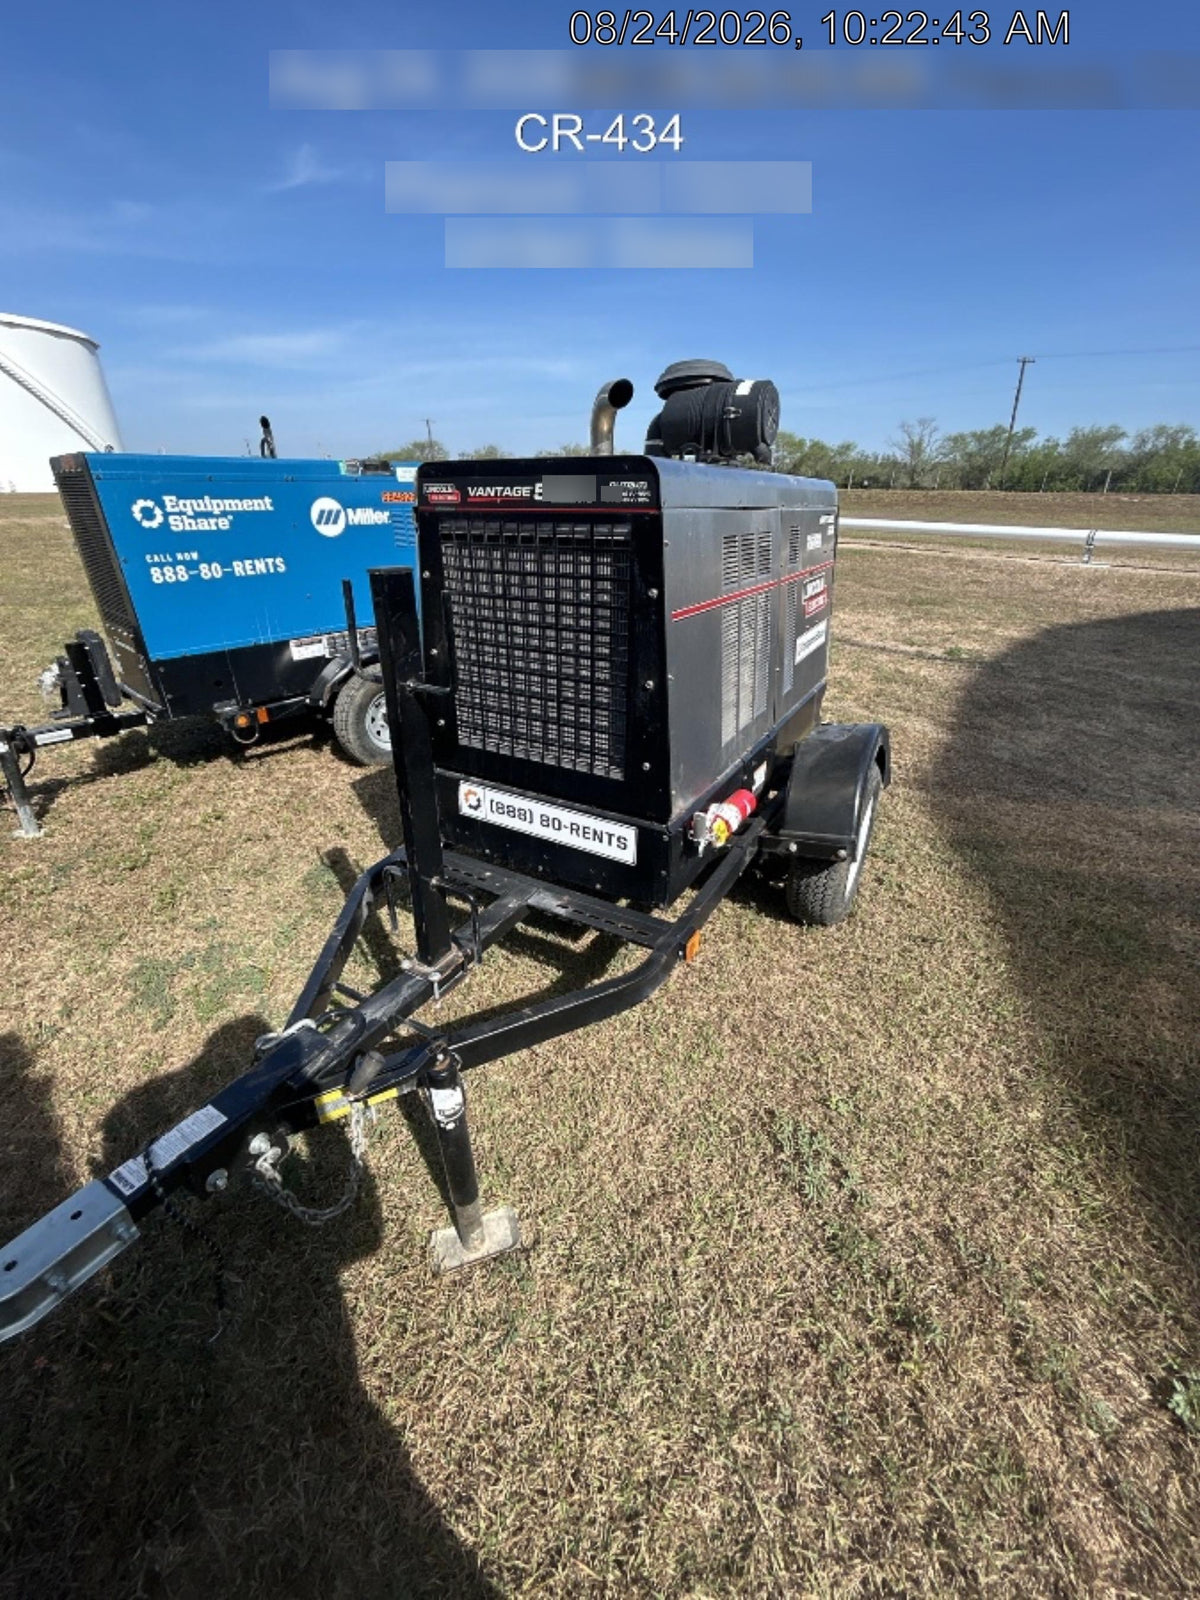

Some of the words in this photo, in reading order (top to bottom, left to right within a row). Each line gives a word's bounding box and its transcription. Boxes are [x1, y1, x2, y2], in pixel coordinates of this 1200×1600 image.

[467, 485, 531, 498] VANTAGE
[162, 495, 274, 514] Equipment
[168, 515, 232, 531] Share
[347, 507, 390, 526] Miller
[145, 553, 173, 563] CALL
[176, 551, 199, 561] NOW
[150, 557, 286, 584] 888-80-RENTS
[490, 799, 533, 824] (888)
[540, 814, 628, 850] 80-RENTS
